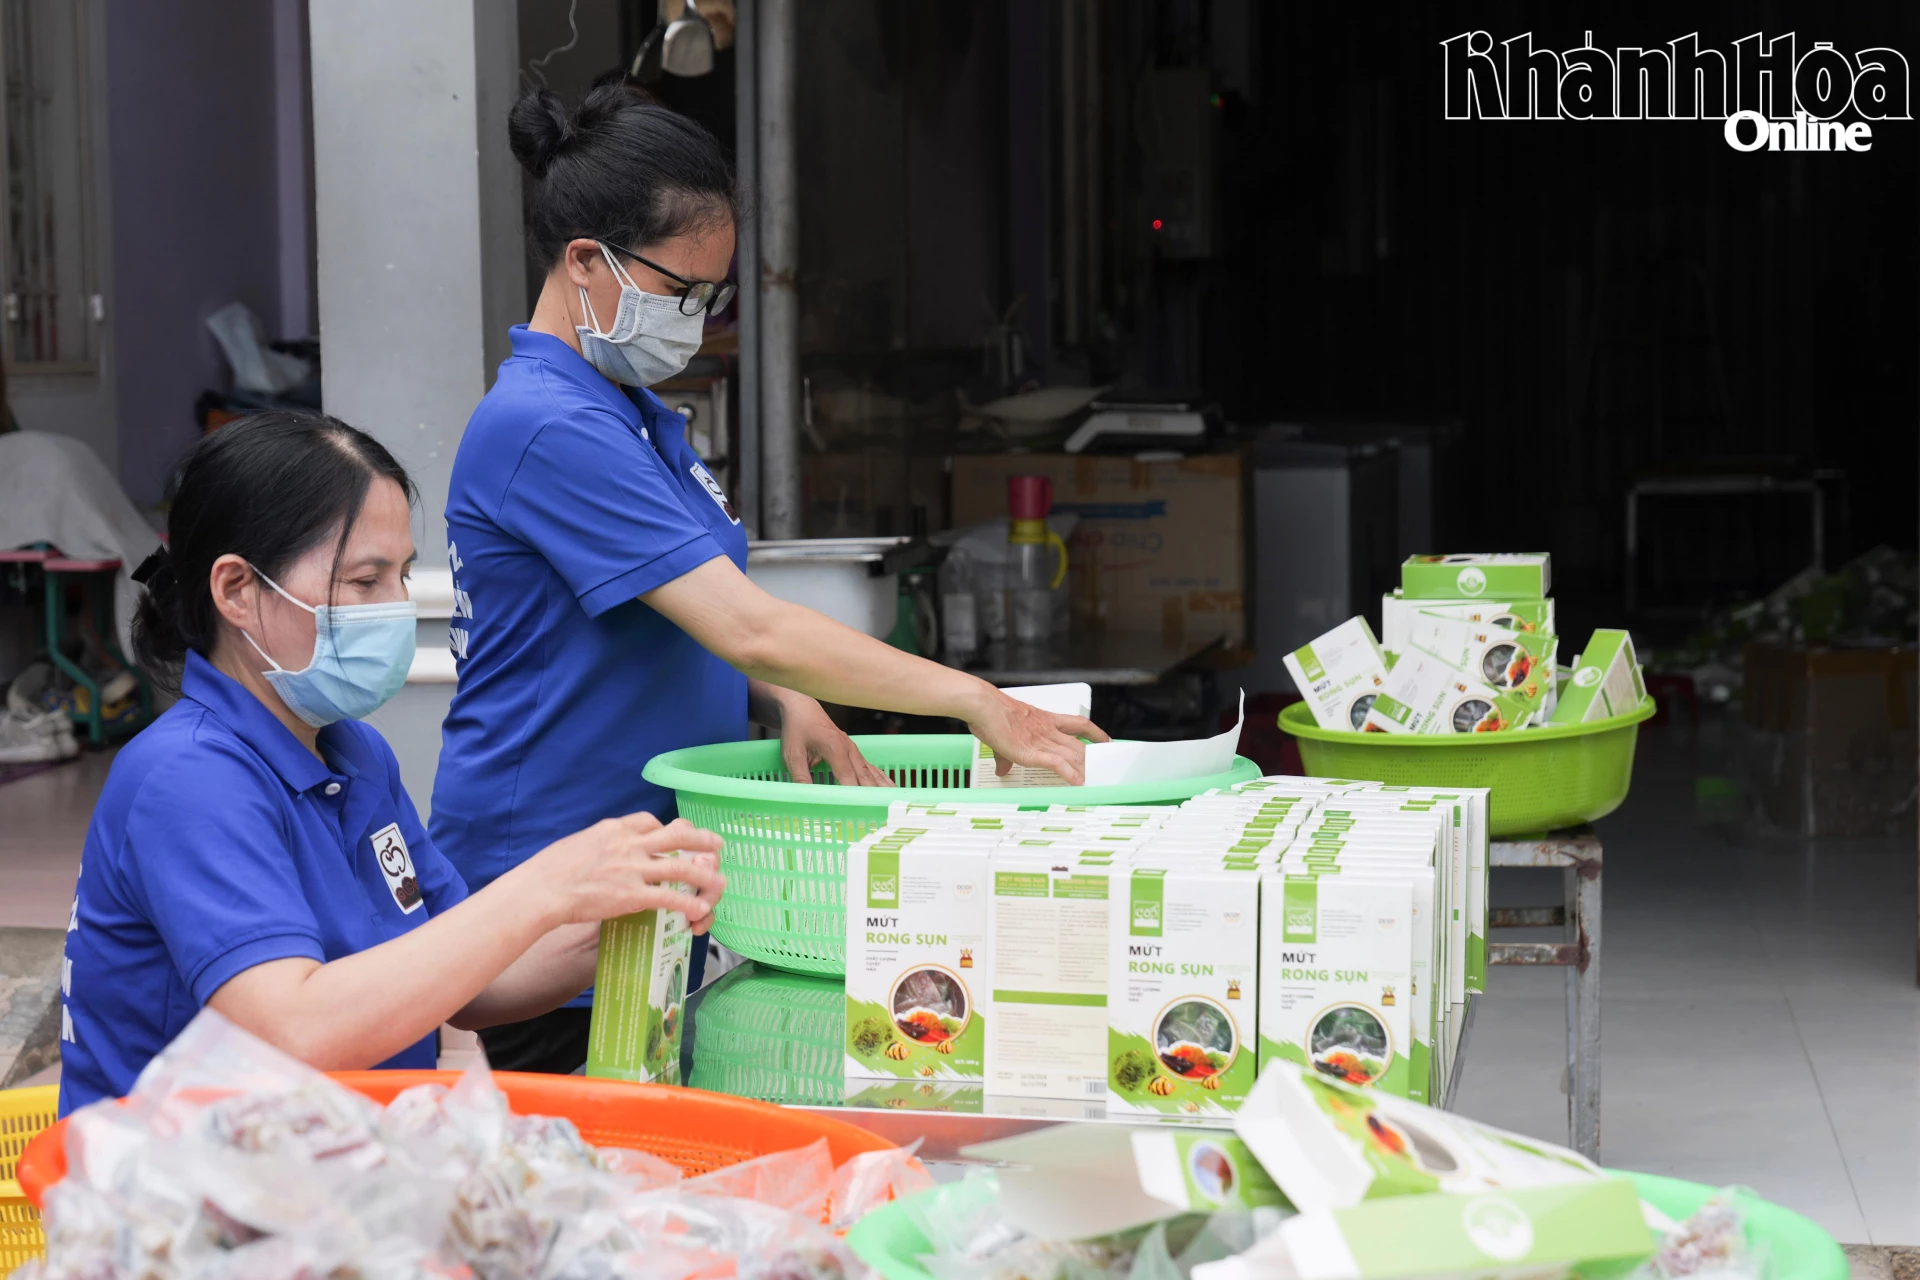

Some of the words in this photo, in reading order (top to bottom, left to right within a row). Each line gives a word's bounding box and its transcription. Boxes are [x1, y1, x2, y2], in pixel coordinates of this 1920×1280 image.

[866, 914, 899, 928] MỨT
[866, 932, 911, 945] RONG
[916, 933, 948, 948] SỤN
[1129, 942, 1163, 957] MỨT
[1282, 950, 1317, 964] MỨT
[1128, 961, 1175, 975] RONG
[1181, 963, 1214, 979] SỤN
[1281, 968, 1329, 982] RONG
[1334, 970, 1369, 985] SỤN
